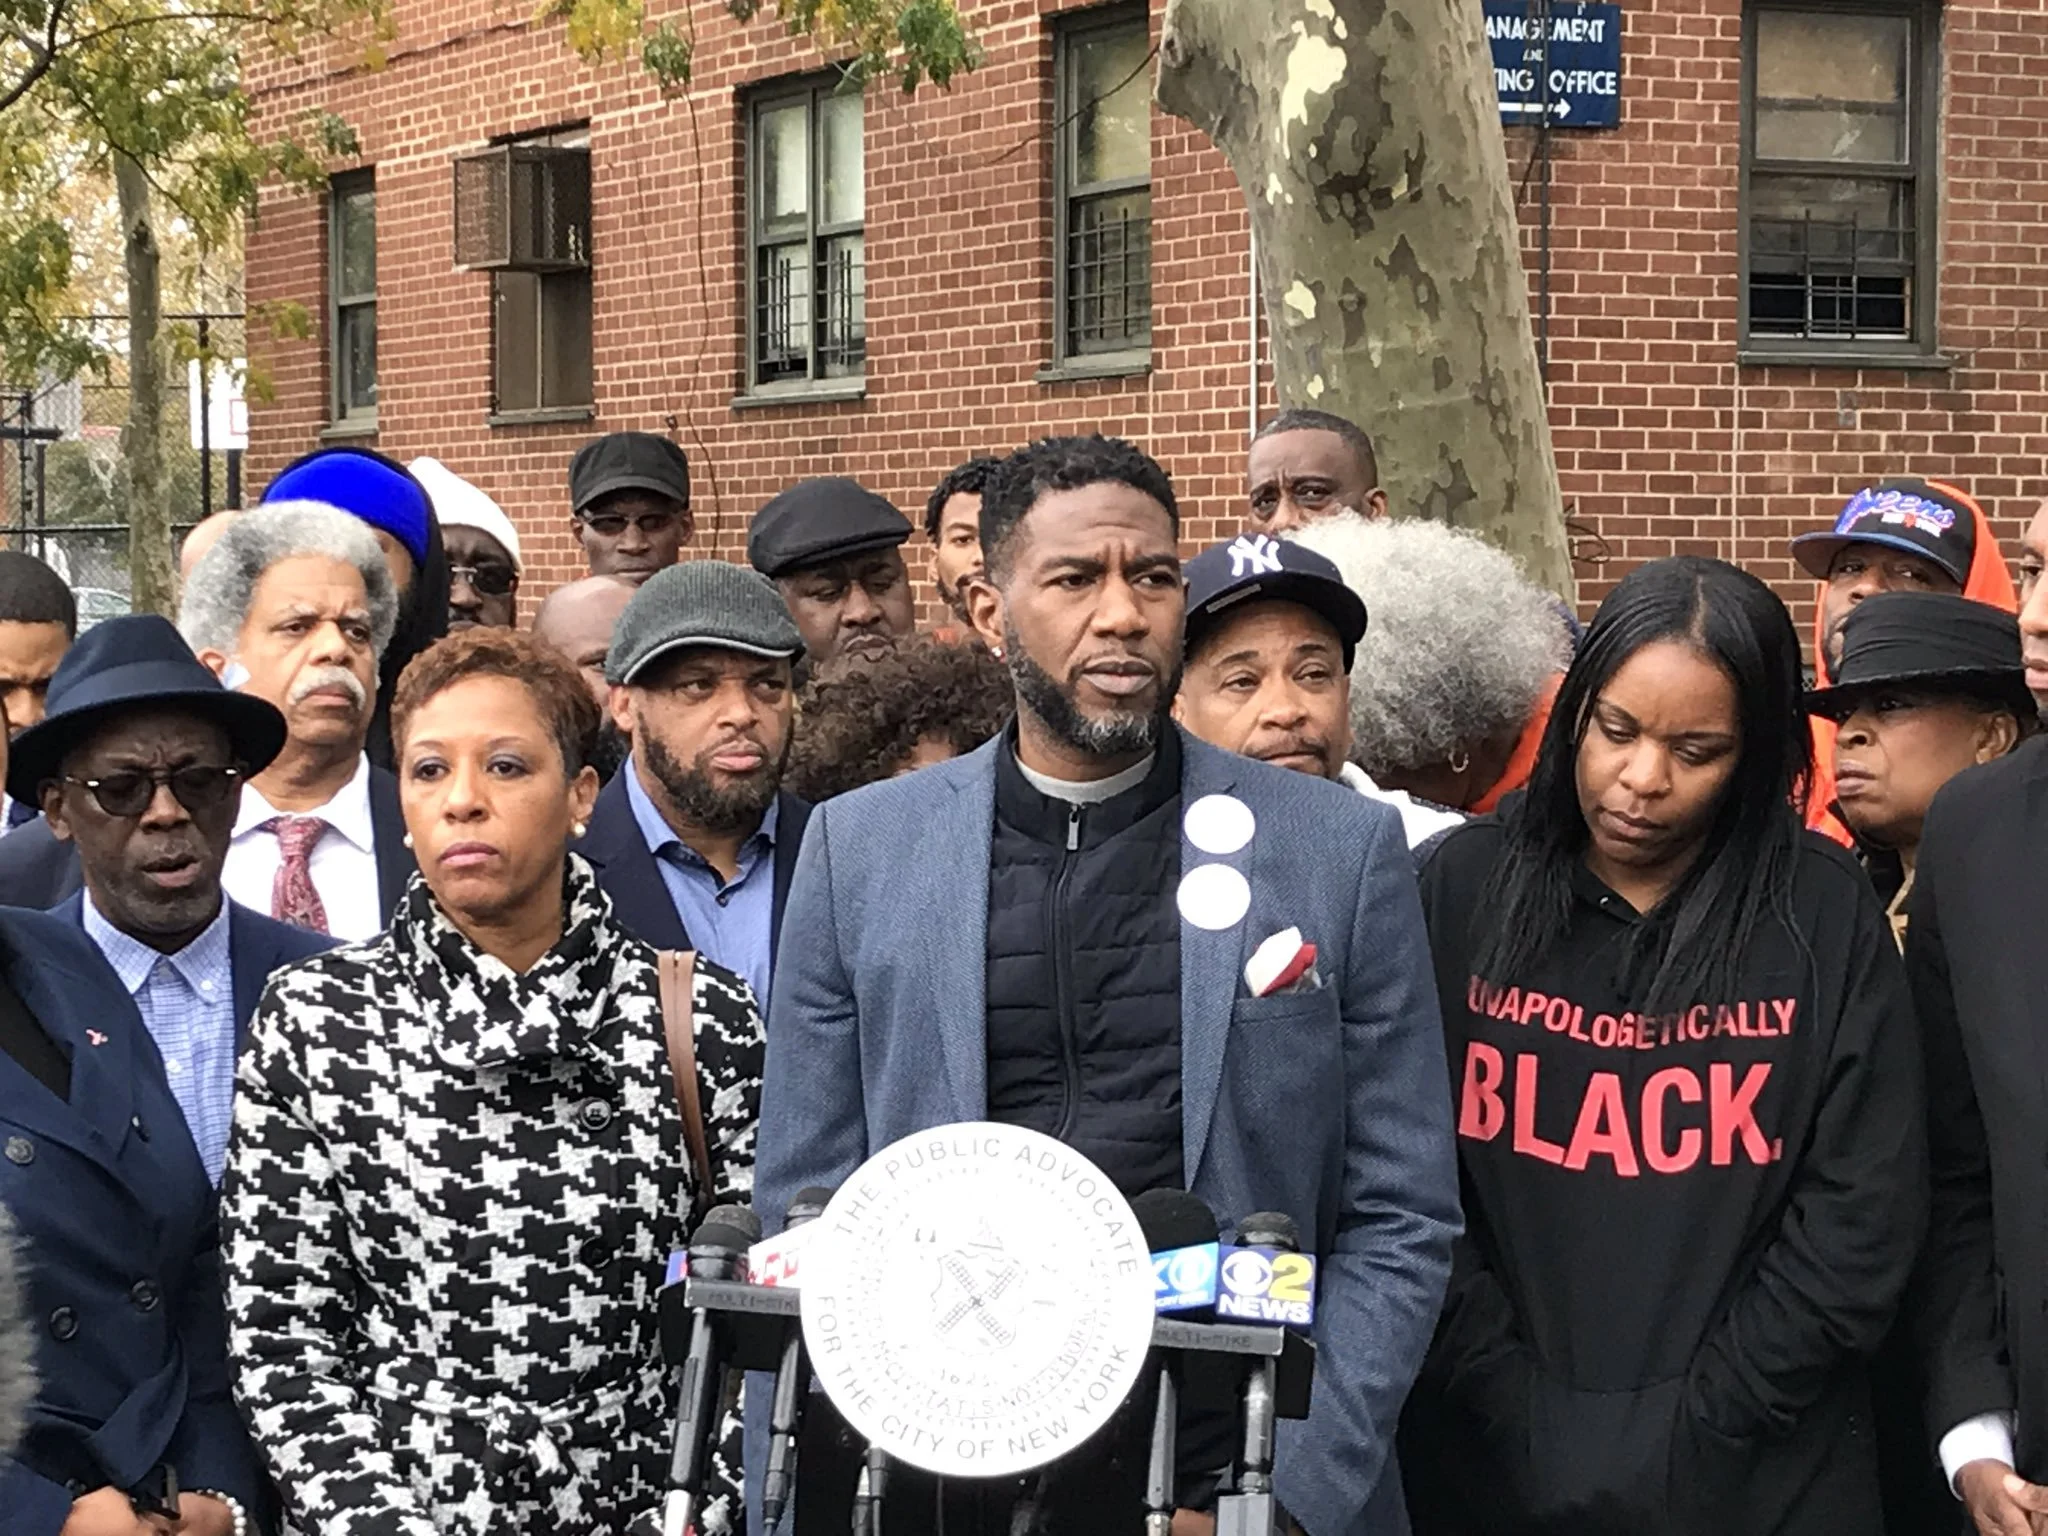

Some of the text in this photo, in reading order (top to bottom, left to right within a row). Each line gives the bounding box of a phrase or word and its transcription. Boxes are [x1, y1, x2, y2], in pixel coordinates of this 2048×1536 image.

[1485, 16, 1605, 43] ANAGEMENT
[1548, 69, 1617, 95] OFFICE
[1467, 974, 1796, 1050] UNAPOLOGETICALLY
[1459, 1041, 1782, 1177] BLACK.
[834, 1182, 880, 1235] THE
[885, 1138, 1002, 1180] PUBLIC
[1014, 1143, 1138, 1277] ADVOCATE
[1218, 1293, 1312, 1324] NEWS
[1268, 1253, 1313, 1303] 2
[816, 1295, 843, 1355] FOR
[837, 1364, 877, 1416] THE
[880, 1415, 945, 1454] CITY
[957, 1439, 995, 1459] OF
[1007, 1416, 1071, 1456] NEW
[1074, 1344, 1130, 1416] YORK
